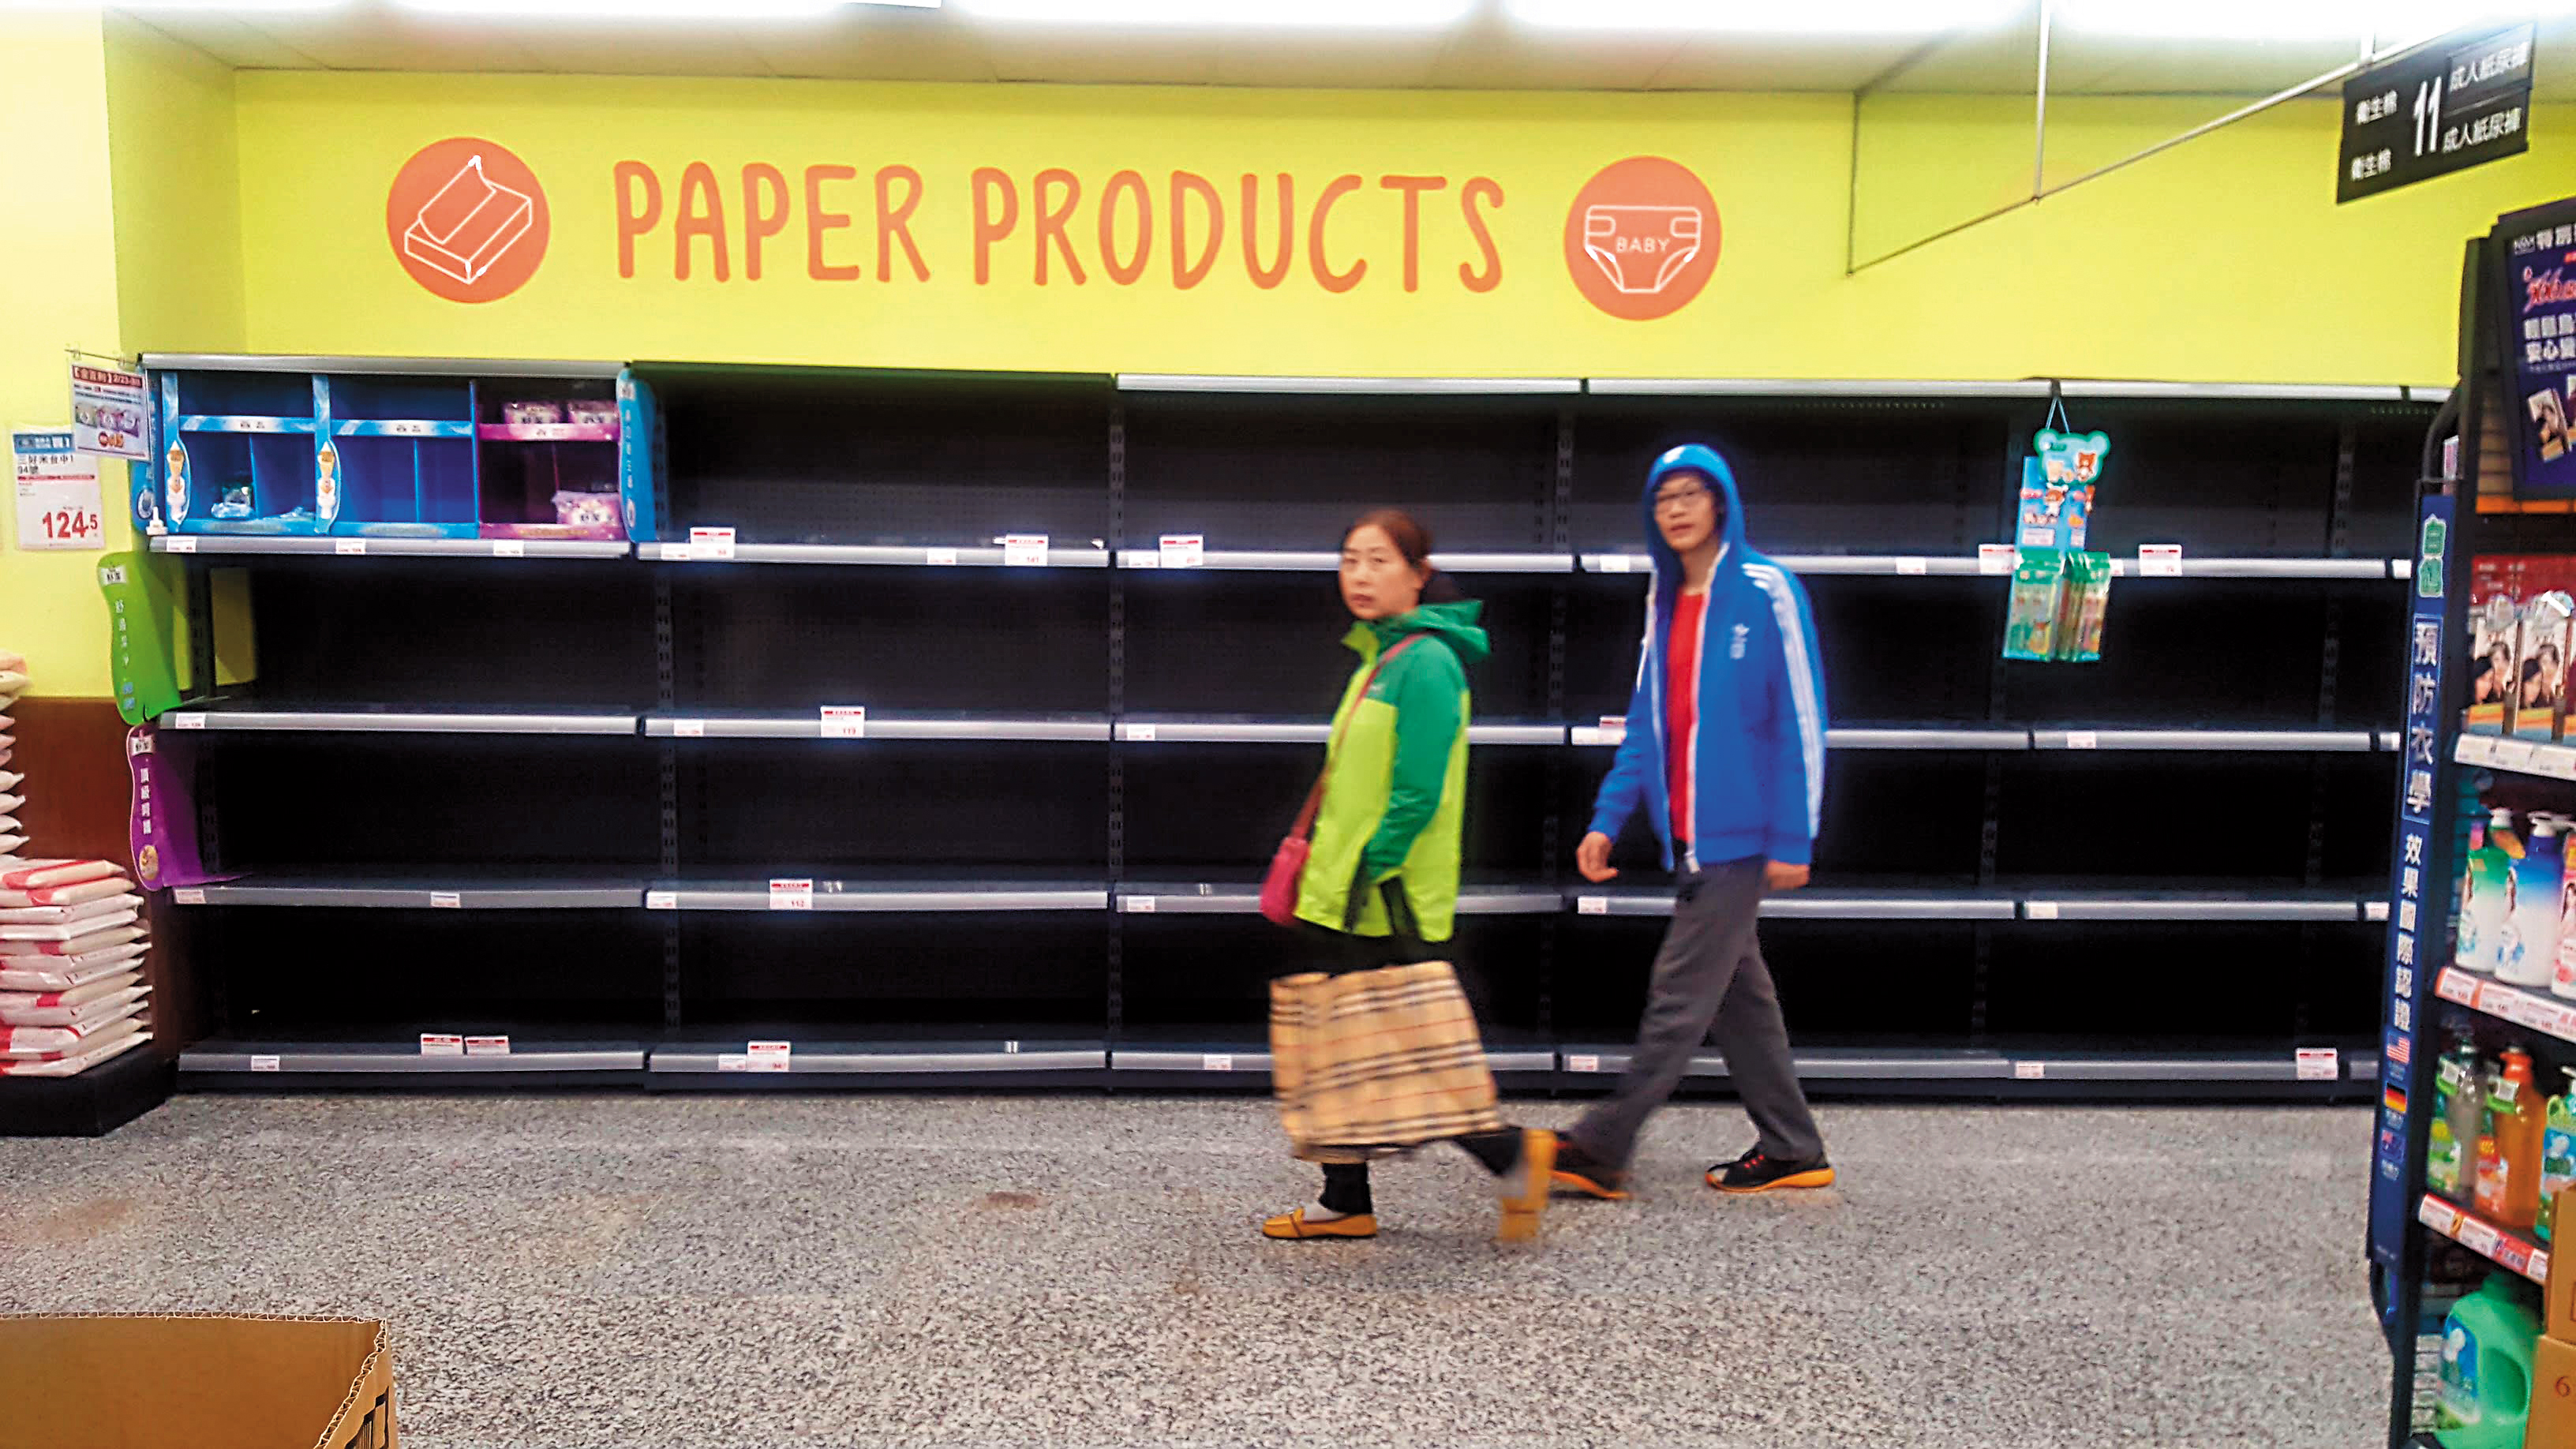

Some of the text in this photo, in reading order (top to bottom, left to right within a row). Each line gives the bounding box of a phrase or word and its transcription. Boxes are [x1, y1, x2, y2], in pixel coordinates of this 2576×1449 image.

[2413, 76, 2443, 157] 11
[613, 160, 1505, 293] PAPER PRODUCTS
[1616, 236, 1671, 253] BABY
[2407, 622, 2439, 813] 預防衣學
[2555, 1376, 2570, 1398] 6
